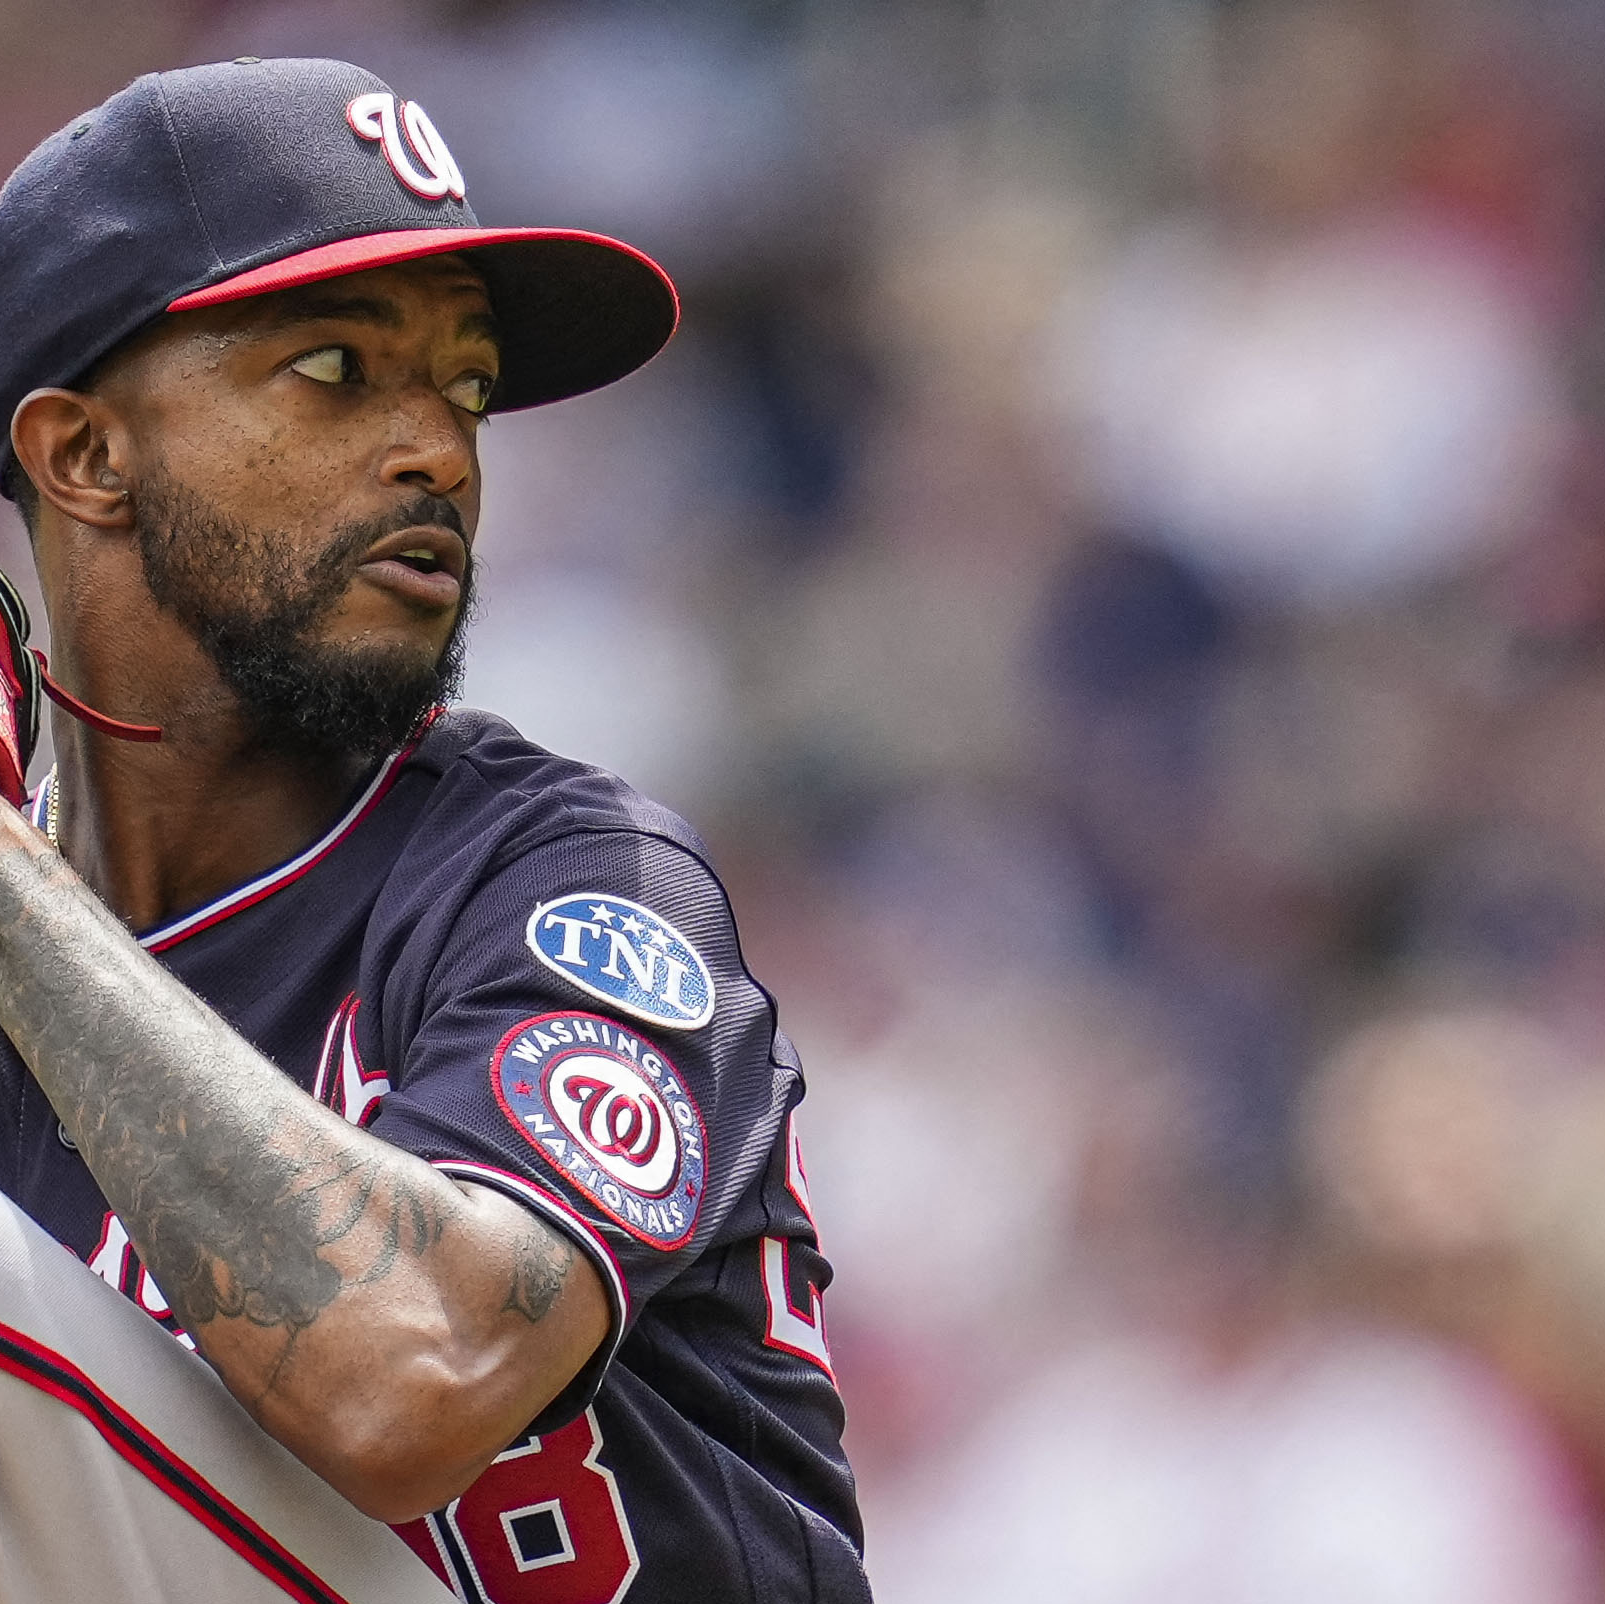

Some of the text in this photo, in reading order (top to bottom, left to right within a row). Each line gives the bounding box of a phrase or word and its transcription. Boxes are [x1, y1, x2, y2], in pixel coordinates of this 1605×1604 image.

[544, 913, 703, 1019] TNL
[511, 1019, 702, 1160] WASHINGTON
[563, 1074, 661, 1167] W
[523, 1112, 686, 1234] NATIONALS
